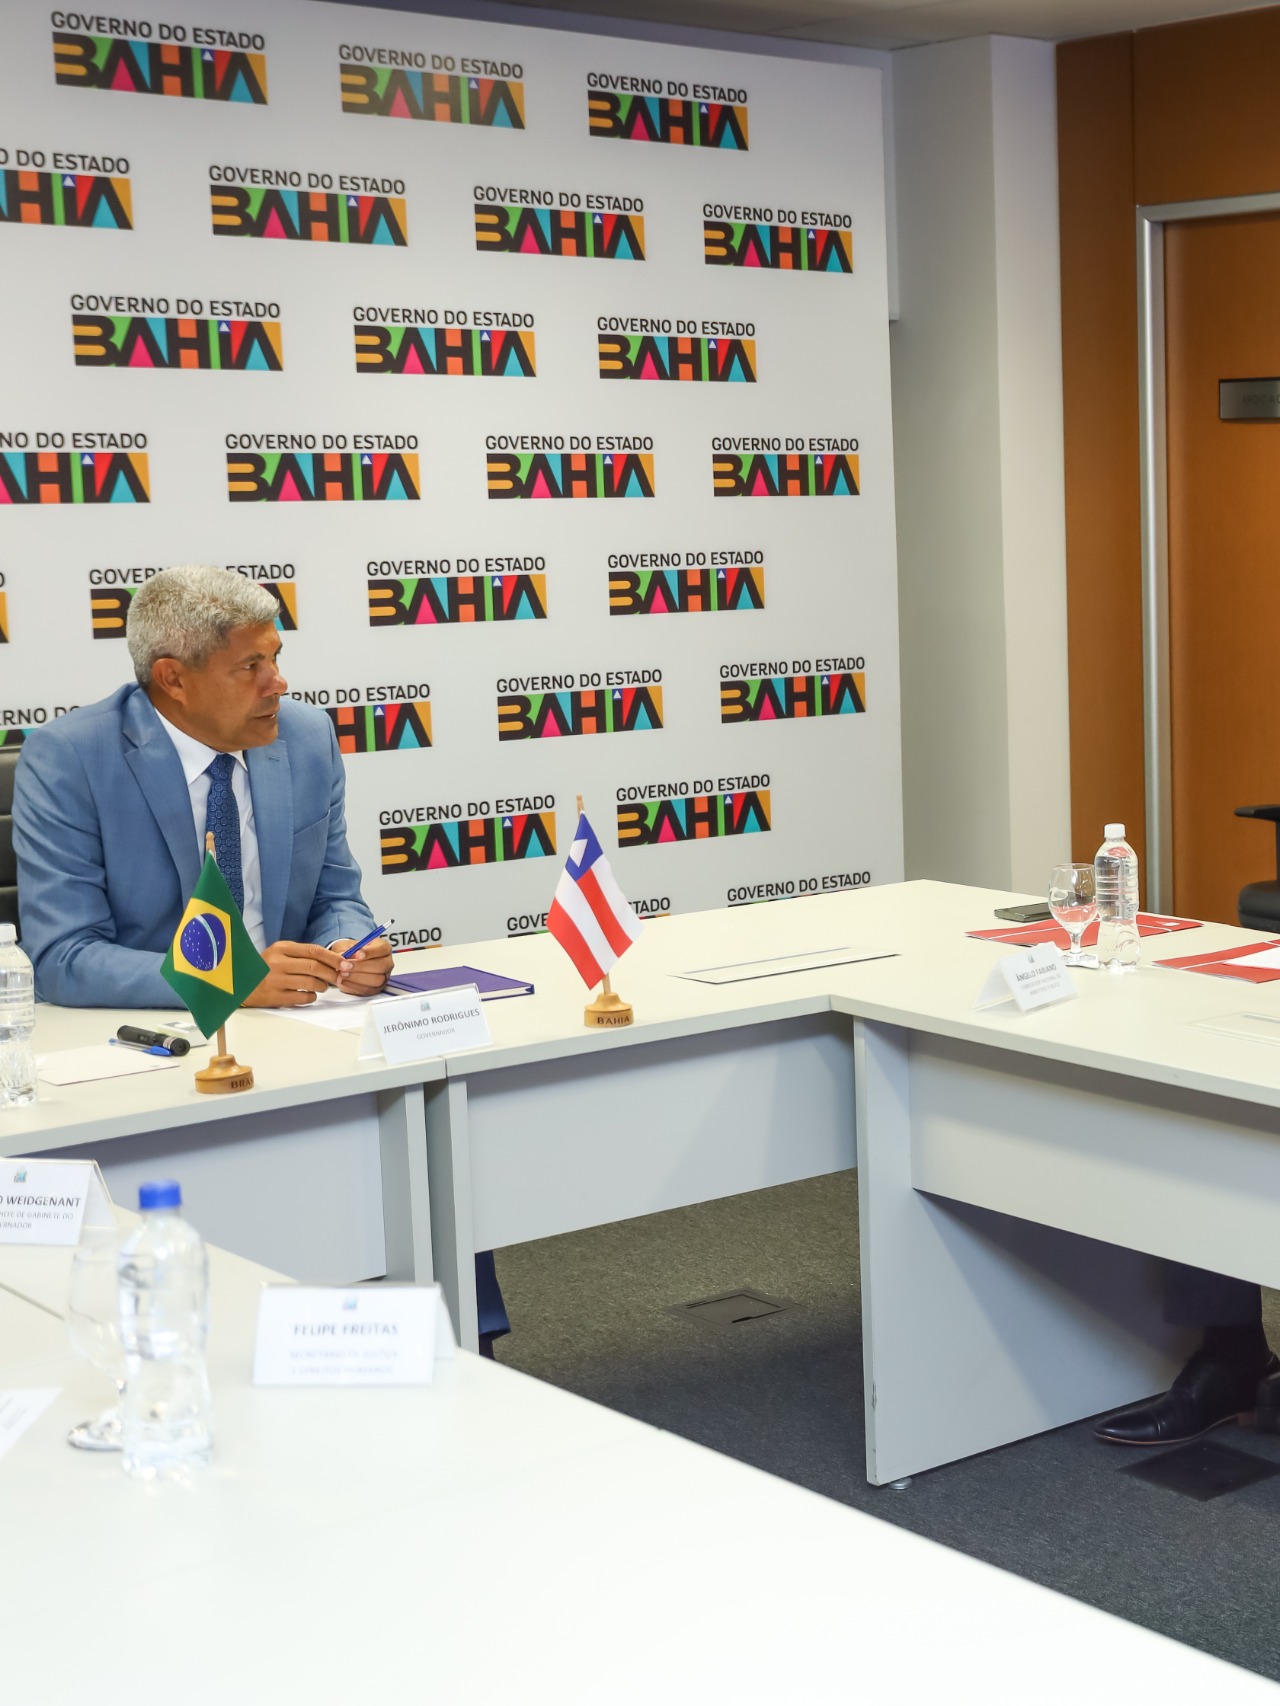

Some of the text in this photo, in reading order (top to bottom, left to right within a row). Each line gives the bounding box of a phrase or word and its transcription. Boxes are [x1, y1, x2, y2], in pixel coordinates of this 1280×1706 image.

[51, 11, 265, 51] GOVERNO DO ESTADO
[52, 31, 268, 105] BAHIA
[338, 44, 524, 79] GOVERNO DO ESTADO
[339, 63, 526, 130] BAHIA
[587, 72, 748, 104] GOVERNO DO ESTADO
[587, 90, 749, 151] BAHIA
[15, 149, 46, 169] DO
[53, 152, 130, 174] ESTADO
[208, 164, 406, 196] GOVERNO DO ESTADO
[473, 185, 644, 213] GOVERNO DO ESTADO
[209, 184, 409, 247] BAHIA
[702, 203, 853, 229] GOVERNO DO ESTADO
[474, 203, 646, 261] BAHIA
[703, 220, 853, 274] BAHIA
[71, 294, 281, 319] GOVERNO DO ESTADO
[353, 306, 535, 329] GOVERNO DO ESTADO
[597, 316, 756, 337] GOVERNO DO ESTADO
[71, 314, 284, 372] BAHIA
[354, 324, 537, 378] BAHIA
[597, 333, 757, 383] BAHIA
[36, 432, 65, 449] DO
[72, 432, 148, 450] ESTADO
[225, 433, 419, 450] GOVERNO DO ESTADO
[485, 435, 654, 451] GOVERNO DO ESTADO
[711, 436, 860, 452] GOVERNO DO ESTADO
[226, 452, 421, 502] BAHIA
[486, 453, 655, 499] BAHIA
[712, 453, 860, 497] BAHIA
[366, 556, 546, 577] GOVERNO DO ESTADO
[607, 550, 764, 569] GOVERNO DO ESTADO
[367, 573, 548, 627] BAHIA
[608, 566, 765, 616] BAHIA
[496, 668, 663, 694] GOVERNO DO ESTADO
[719, 656, 866, 679] GOVERNO DO ESTADO
[336, 687, 361, 704] DO
[366, 683, 431, 702] ESTADO
[720, 672, 866, 724] BAHIA
[497, 685, 664, 742] BAHIA
[616, 773, 771, 802] GOVERNO DO ESTADO
[378, 794, 556, 826] GOVERNO DO ESTADO
[617, 789, 772, 848] BAHIA
[380, 811, 557, 875] BAHIA
[727, 871, 871, 902] GOVERNO DO ESTADO
[383, 1008, 480, 1034] JERÔNIMO RODRIGUES
[597, 1015, 630, 1025] BAHIA
[6, 1195, 81, 1207] WEIDGENANT
[293, 1323, 399, 1336] FELIPE FREITAS
